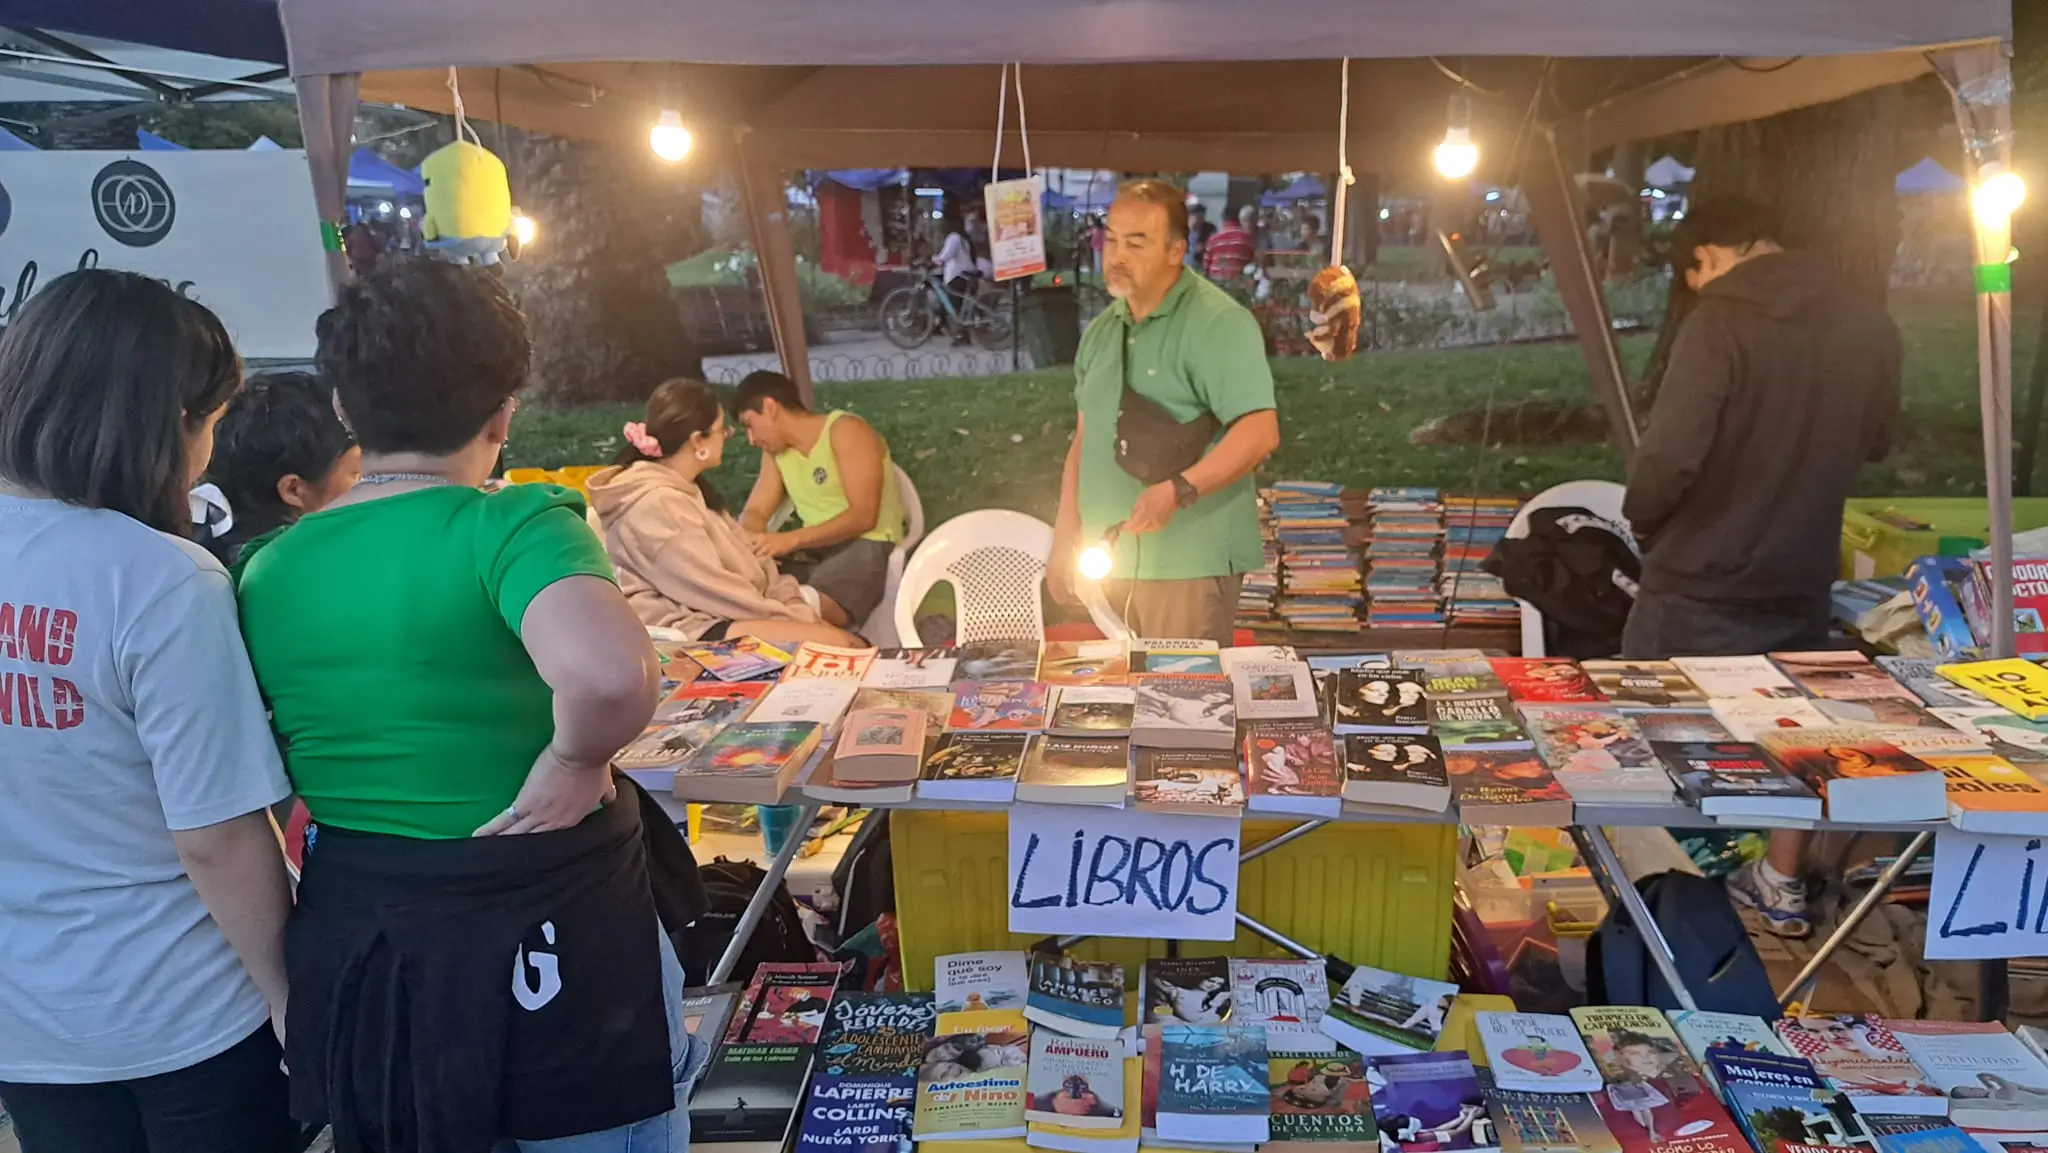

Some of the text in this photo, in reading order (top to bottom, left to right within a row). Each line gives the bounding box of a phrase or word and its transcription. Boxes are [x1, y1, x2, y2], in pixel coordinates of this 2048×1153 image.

[1968, 671, 2027, 685] NO
[1012, 829, 1234, 915] LiBROS
[947, 959, 984, 968] Dime
[947, 964, 1002, 977] qué soy
[1038, 984, 1113, 1005] VELASCO
[843, 1015, 929, 1032] REBELDES
[1045, 1044, 1110, 1059] AMPUERO
[1169, 1063, 1226, 1080] H DE
[1723, 1063, 1792, 1082] Mujeres
[1793, 1074, 1815, 1086] en
[813, 1085, 914, 1100] LAPIERRE
[926, 1078, 1020, 1093] Autoestima
[1174, 1078, 1253, 1095] HARRY
[812, 1106, 908, 1121] COLLINS
[1271, 1114, 1365, 1126] CUENTOS
[833, 1124, 880, 1137] ¿ARDE
[802, 1133, 908, 1145] NUEVA YORK?
